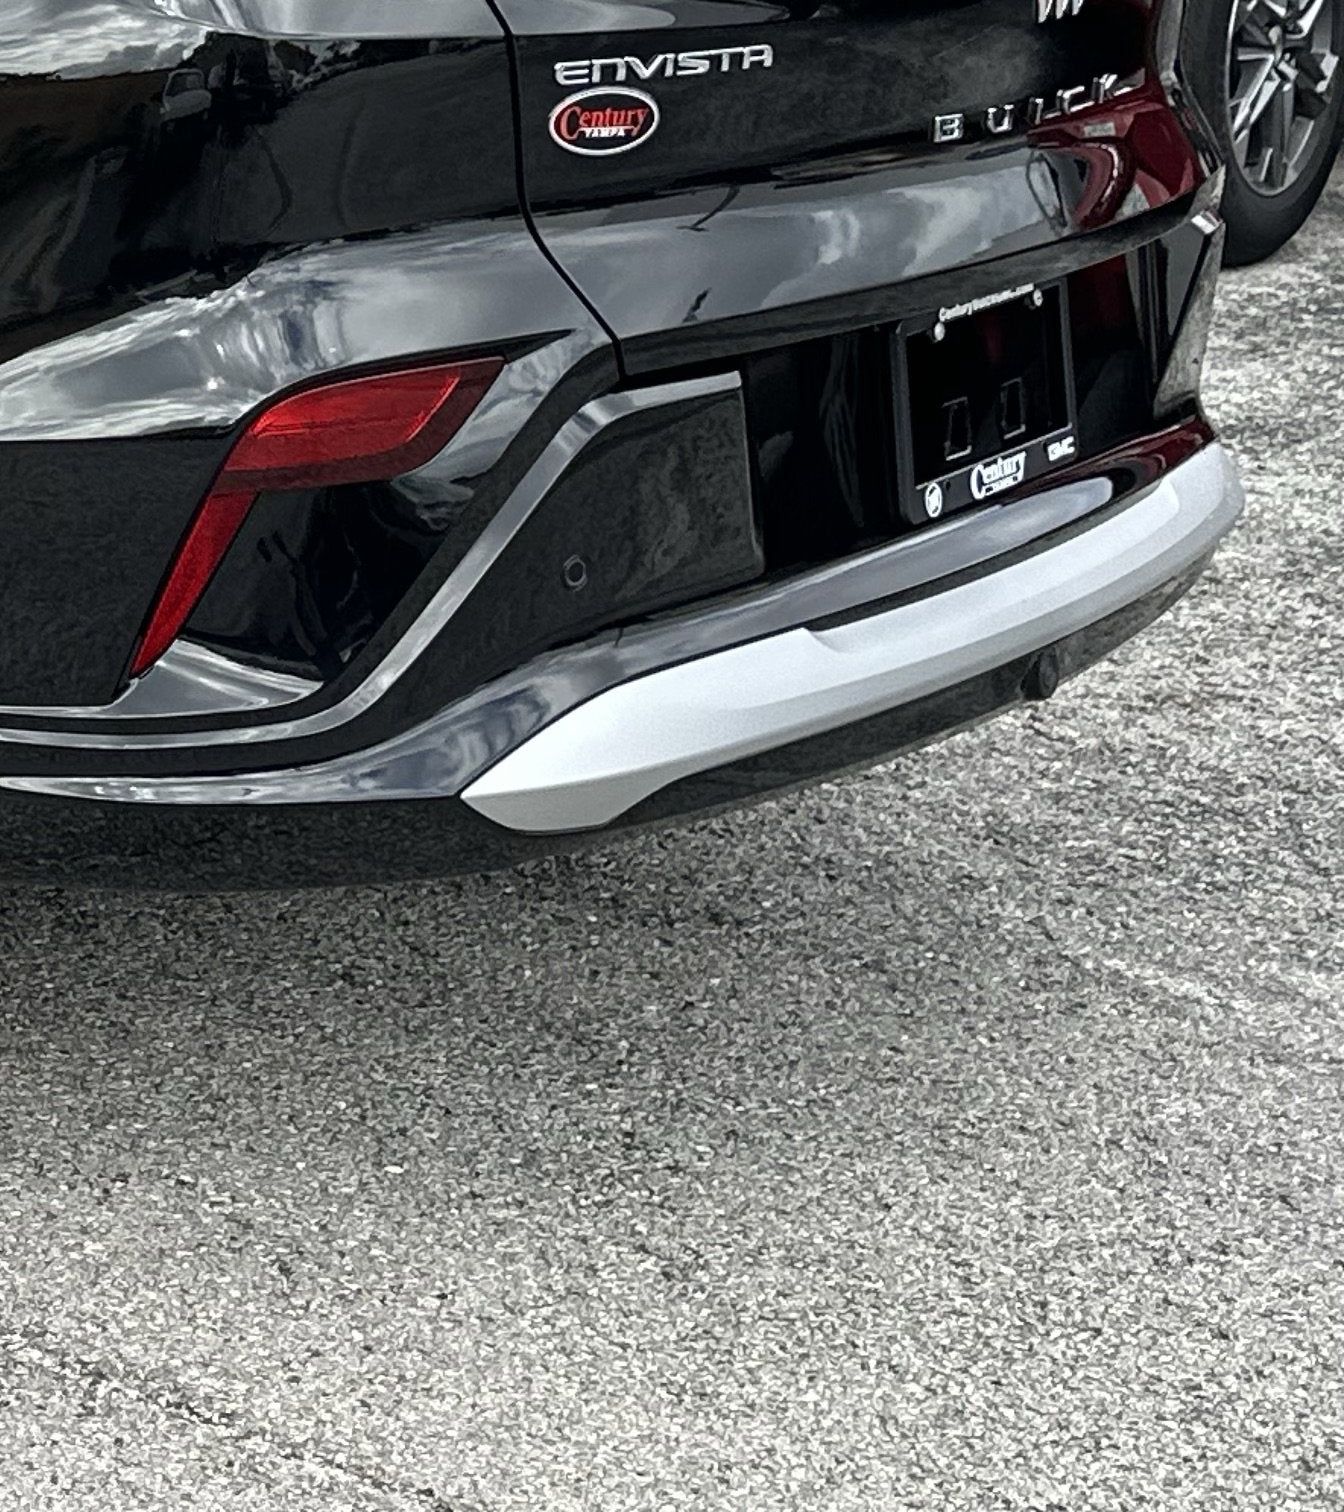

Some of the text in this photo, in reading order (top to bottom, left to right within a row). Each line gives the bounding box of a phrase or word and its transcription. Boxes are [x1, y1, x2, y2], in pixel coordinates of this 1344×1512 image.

[553, 44, 774, 86] ENVISTA
[559, 105, 650, 141] Century
[933, 73, 1134, 144] BUICK
[584, 127, 627, 139] TAMPA
[970, 451, 1027, 500] Century
